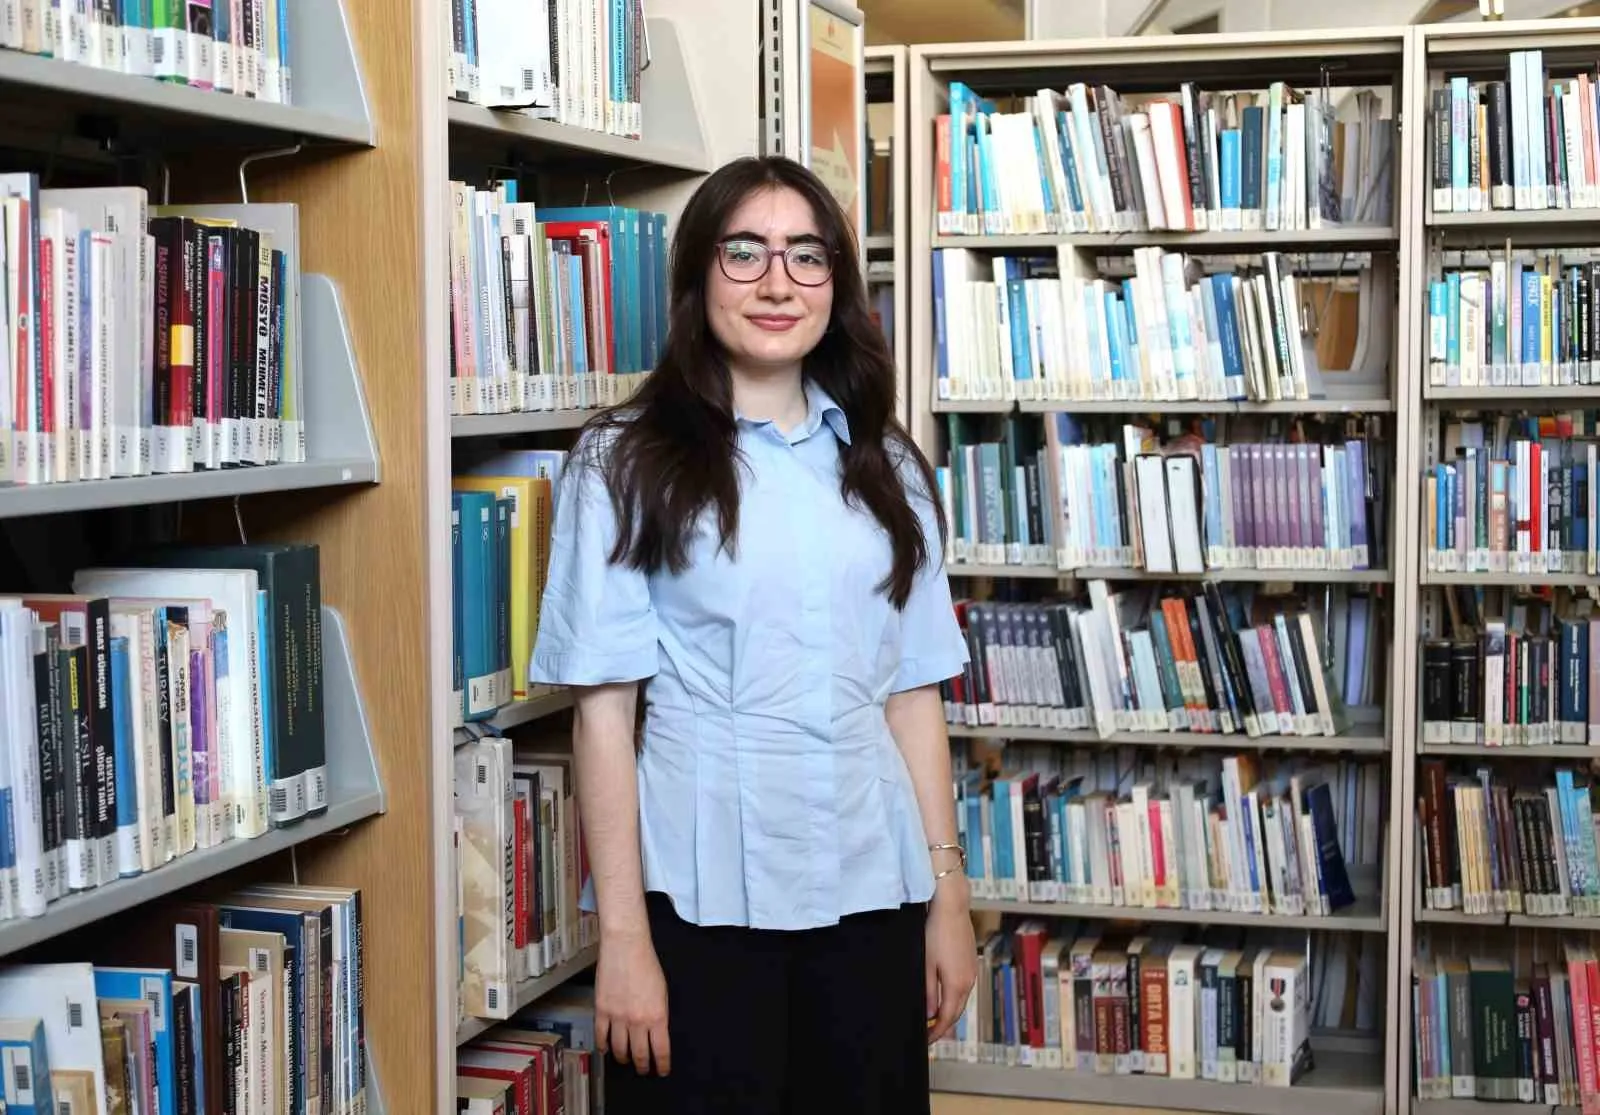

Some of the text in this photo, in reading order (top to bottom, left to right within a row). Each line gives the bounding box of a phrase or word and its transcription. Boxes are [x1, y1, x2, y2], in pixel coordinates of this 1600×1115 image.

[65, 237, 76, 254] 31
[67, 256, 75, 287] MART
[257, 348, 267, 402] MEHMET
[257, 403, 266, 419] BA
[95, 616, 105, 651] BERAY
[159, 655, 168, 722] TURKEY
[95, 745, 108, 823] ŞİDDET TARİHİ
[105, 755, 115, 806] DEVLETİN
[1146, 983, 1166, 1052] ORTA DOĞ
